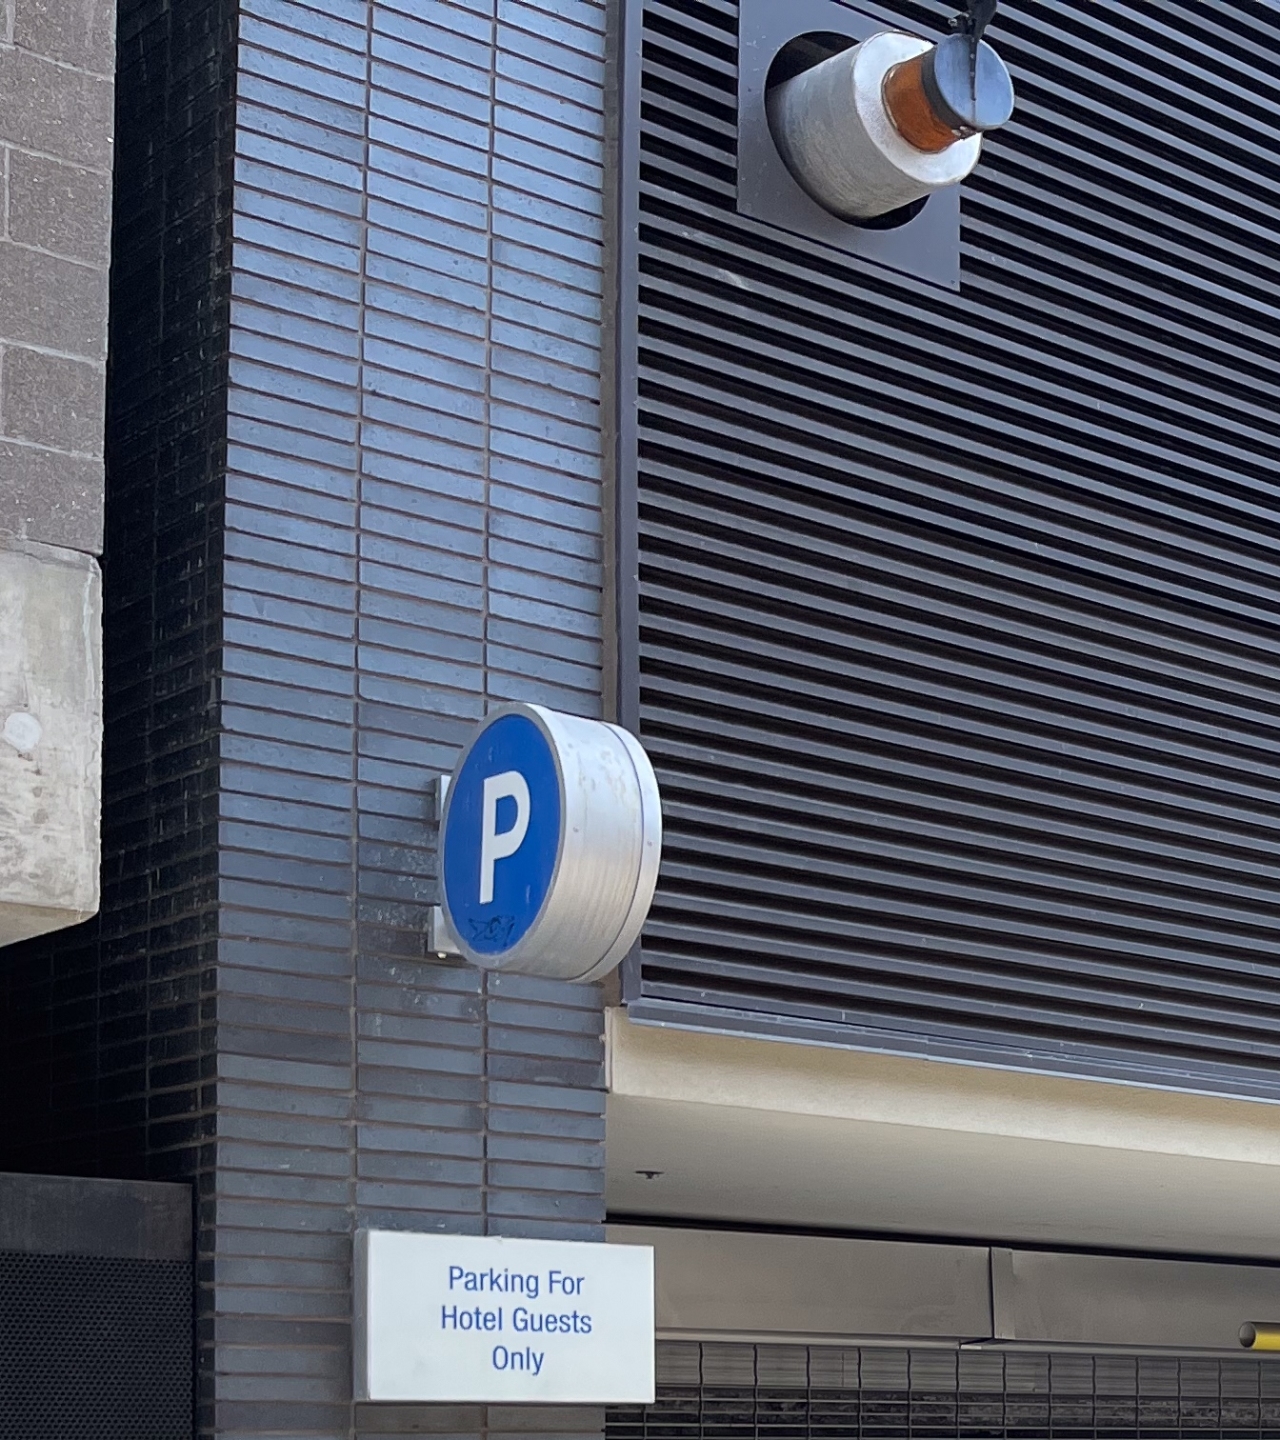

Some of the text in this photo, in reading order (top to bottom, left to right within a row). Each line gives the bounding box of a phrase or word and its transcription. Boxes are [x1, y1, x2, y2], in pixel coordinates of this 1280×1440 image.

[479, 770, 531, 905] P
[449, 1266, 585, 1299] Parking For
[441, 1305, 592, 1333] Hotel Guests
[492, 1345, 545, 1376] Only
